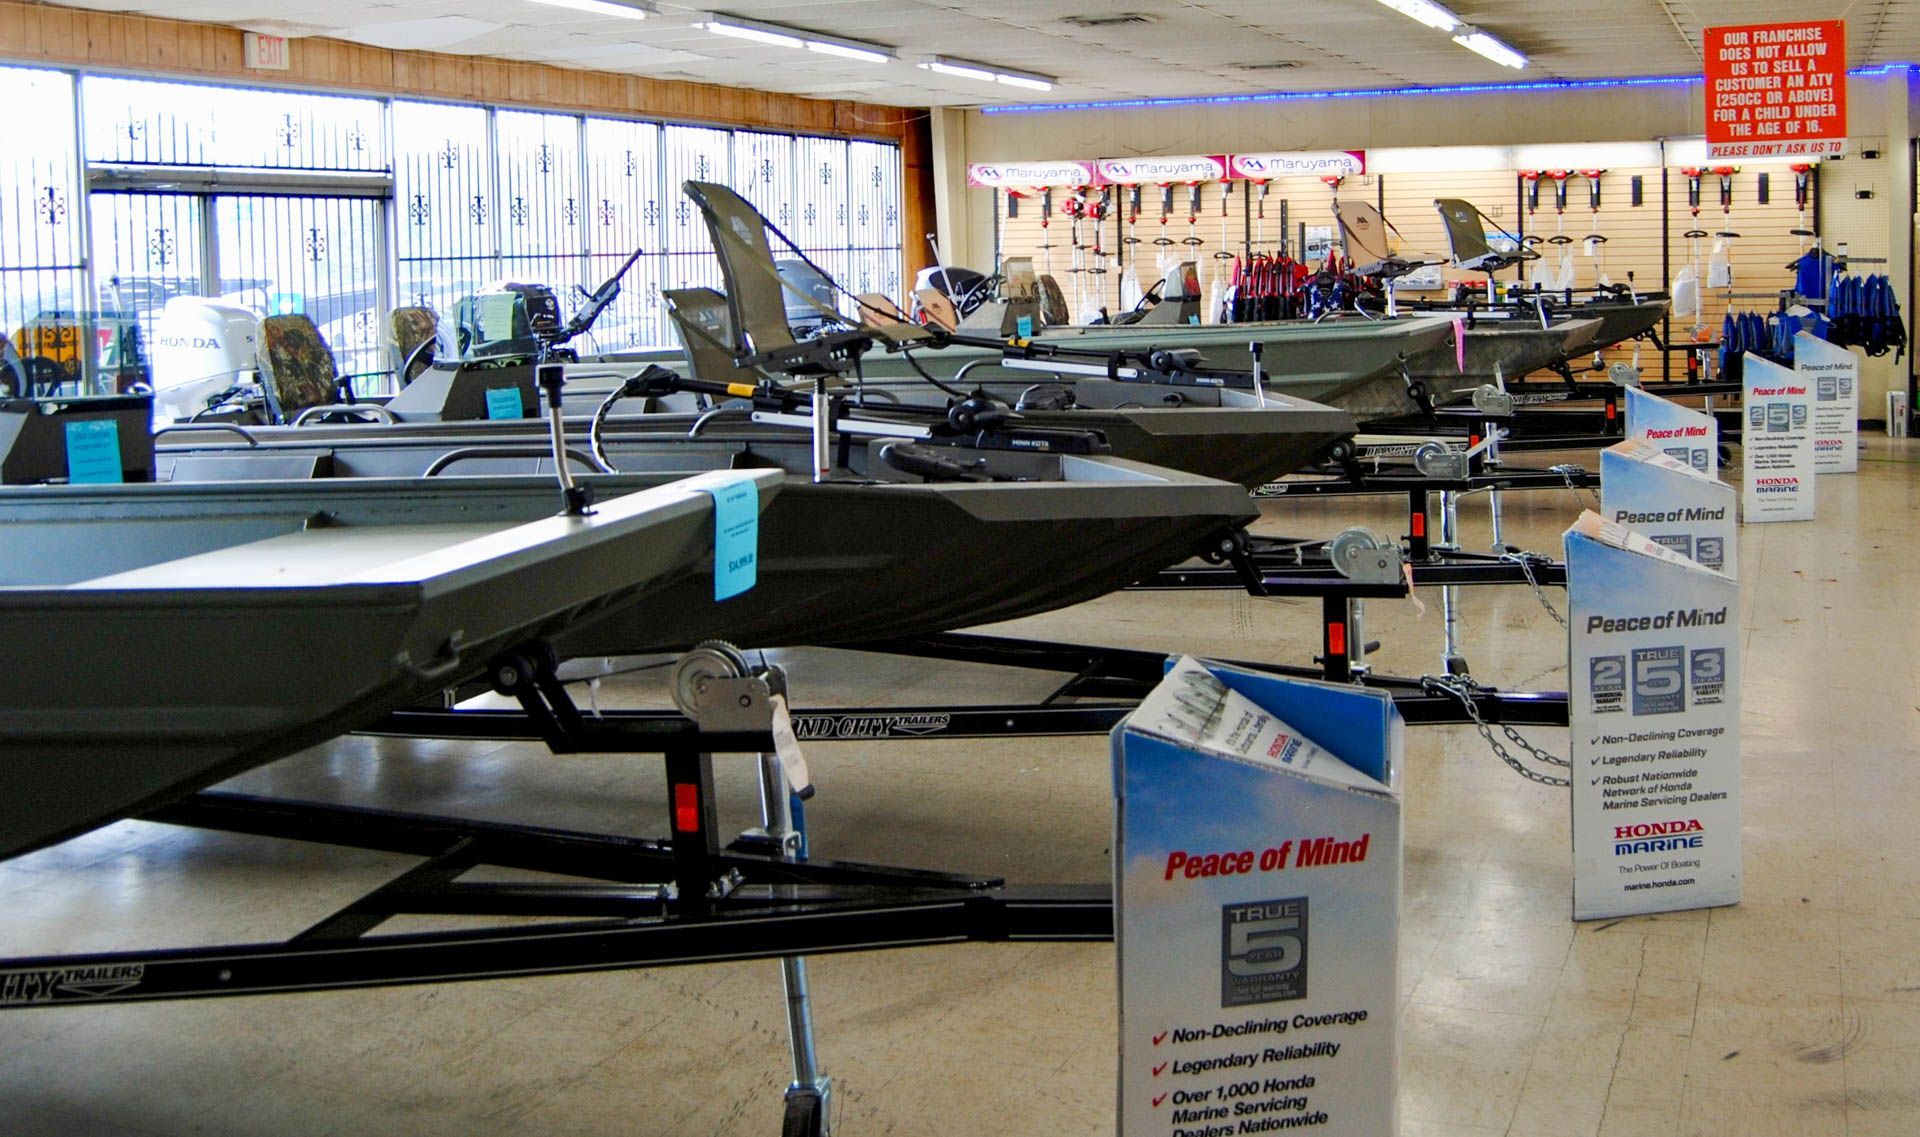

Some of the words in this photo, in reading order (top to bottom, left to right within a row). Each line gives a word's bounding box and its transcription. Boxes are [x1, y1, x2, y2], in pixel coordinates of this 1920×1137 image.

[1724, 32, 1748, 46] OUR
[1753, 27, 1822, 44] FRANCHISE
[1719, 48, 1751, 61] DOES
[1756, 46, 1780, 59] NOT
[1785, 43, 1827, 57] ALLOW
[1731, 63, 1748, 75] US
[1753, 62, 1768, 74] TO
[1773, 60, 1802, 73] SELL
[1807, 59, 1816, 71] A
[1715, 76, 1781, 91] CUSTOMER
[1786, 75, 1804, 88] AN
[1809, 73, 1833, 86] ATV
[1716, 93, 1762, 108] (250CC
[1766, 91, 1783, 104] OR
[1788, 88, 1833, 103] ABOVE)
[1713, 109, 1736, 122] FOR
[1742, 108, 1750, 121] A
[1755, 106, 1790, 119] CHILD
[1795, 104, 1837, 118] UNDER
[1728, 123, 1752, 137] THE
[1757, 122, 1780, 135] AGE
[1785, 121, 1801, 134] OF
[1805, 120, 1823, 133] 16.
[1711, 145, 1749, 157] PLEASE
[1752, 144, 1782, 155] DON'T
[1786, 142, 1806, 154] ASK
[1811, 142, 1825, 152] US
[1829, 141, 1842, 152] TO
[160, 335, 221, 350] HONDA
[1752, 387, 1775, 396] Peace
[1777, 386, 1786, 395] of
[1787, 385, 1806, 395] Mind
[1751, 407, 1764, 420] 2
[1769, 408, 1789, 425] 5
[1792, 406, 1806, 418] 3
[1646, 429, 1672, 439] Peace
[1674, 427, 1683, 436] of
[1685, 426, 1708, 436] Mind
[1693, 450, 1707, 466] 3
[1756, 477, 1800, 486] HONDA
[1615, 510, 1666, 524] Peace
[1667, 508, 1684, 522] of
[1685, 507, 1725, 521] Mind
[1653, 536, 1687, 546] TRUE
[1699, 540, 1721, 560] 3
[1586, 615, 1651, 634] Peace
[1653, 611, 1675, 629] of
[1676, 606, 1727, 628] Mind
[1636, 650, 1679, 661] TRUE
[1593, 660, 1622, 685] 2
[1694, 652, 1721, 678] 3
[1636, 658, 1681, 697] 5
[837, 716, 898, 737] CITY
[895, 714, 950, 725] TRAILERS
[1602, 731, 1675, 745] Non-Declining
[1678, 726, 1725, 739] Coverage
[1602, 752, 1656, 766] Legendary
[1658, 748, 1707, 760] Reliability
[1602, 772, 1639, 785] Robust
[1641, 768, 1698, 781] Nationwide
[1602, 786, 1645, 798] Network
[1648, 783, 1658, 794] of
[1660, 781, 1692, 792] Honda
[1602, 798, 1639, 810] Marine
[1641, 794, 1687, 807] Servicing
[1689, 790, 1727, 802] Dealers
[1614, 819, 1705, 839] HONDA
[1164, 848, 1253, 881] Peace
[1259, 840, 1292, 873] of
[1296, 833, 1369, 868] Mind
[1618, 865, 1633, 874] The
[1635, 863, 1660, 873] Power
[1671, 859, 1701, 871] Boating
[1624, 877, 1695, 892] marine.honda.com
[1230, 903, 1299, 922] TRUE
[1228, 917, 1301, 976] 5
[64, 964, 144, 982] TRAILERS
[1231, 970, 1299, 985] WARRANTY
[1172, 1019, 1288, 1044] Non-Declining
[1292, 1009, 1368, 1029] Coverage
[1172, 1053, 1259, 1075] Legendary
[1262, 1041, 1341, 1063] Reliability
[1172, 1089, 1212, 1105] Over
[1217, 1081, 1259, 1101] 1,000
[1263, 1074, 1316, 1094] Honda
[1172, 1105, 1229, 1125] Marine
[1233, 1096, 1308, 1116] Servicing
[1172, 1122, 1234, 1137] Dealers
[1239, 1111, 1329, 1135] Nationwide
